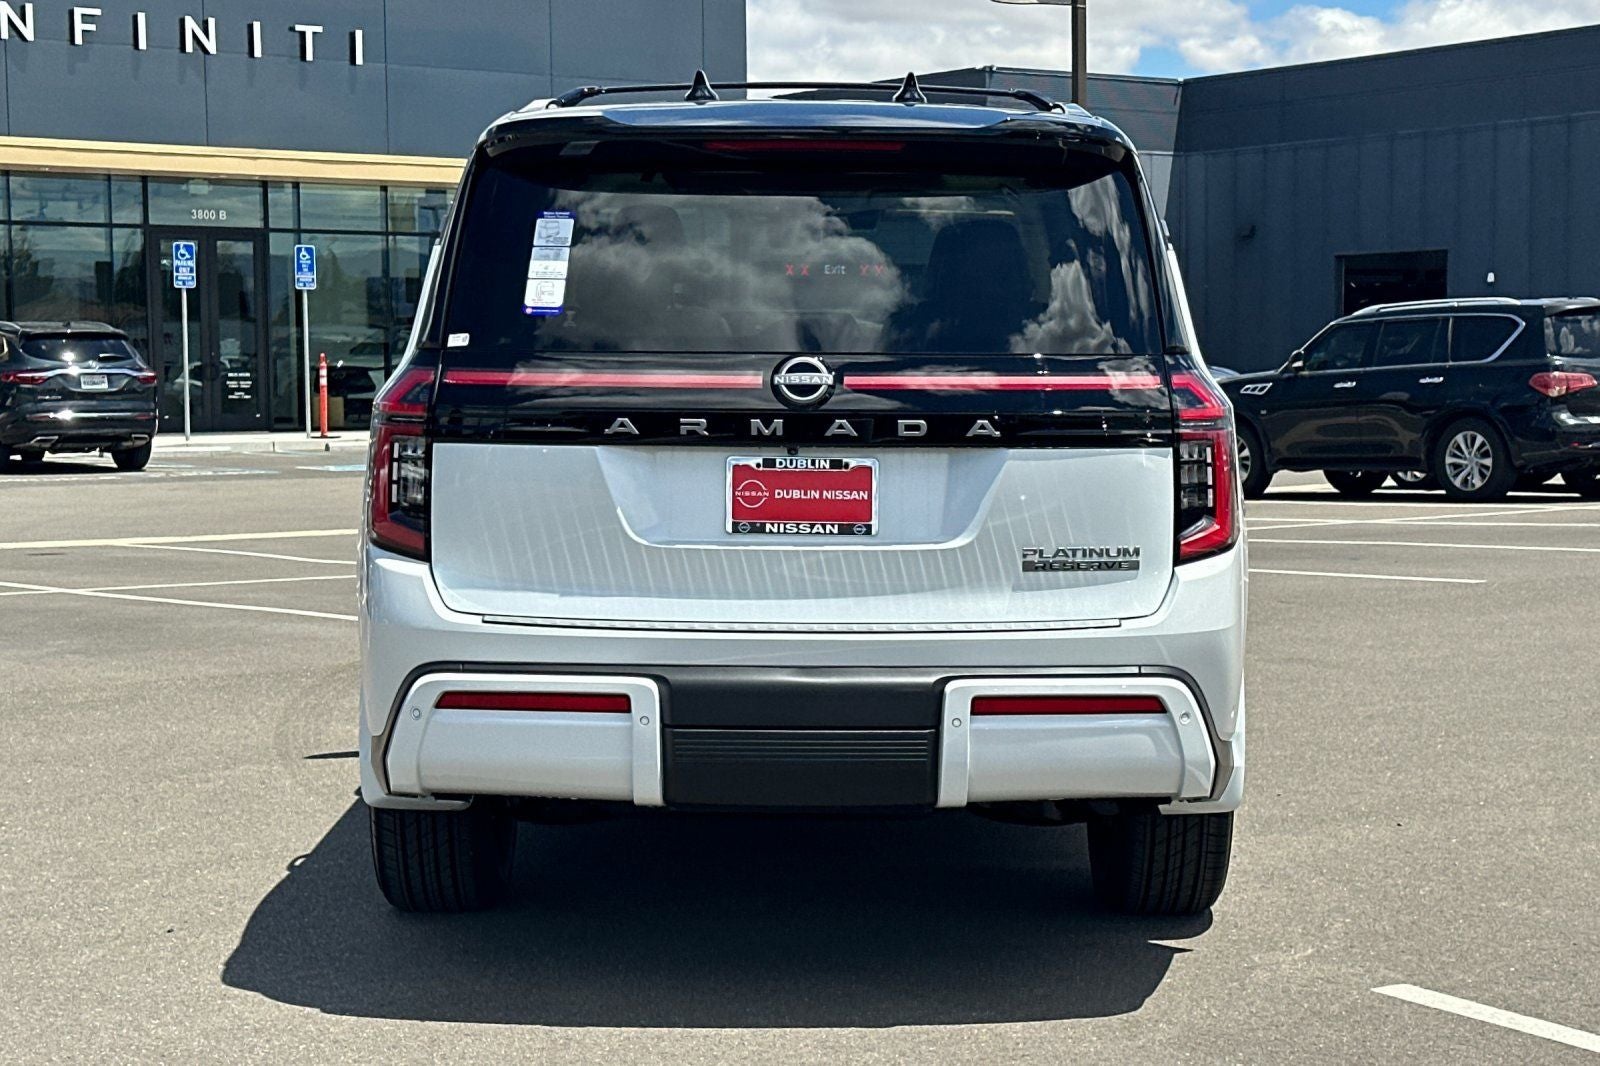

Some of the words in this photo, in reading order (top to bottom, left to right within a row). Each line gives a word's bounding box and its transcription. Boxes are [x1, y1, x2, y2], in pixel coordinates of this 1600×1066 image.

[191, 209, 216, 220] 3800
[219, 210, 227, 220] B
[824, 265, 846, 275] Exit
[774, 375, 831, 385] NISSAN
[604, 417, 1001, 437] ARMADA
[775, 458, 830, 470] DUBLIN
[774, 489, 820, 499] DUBLIN
[823, 490, 868, 500] NISSAN
[765, 523, 839, 534] NISSAN
[1022, 546, 1140, 559] PLATINUM
[1034, 561, 1130, 571] RESERVE
